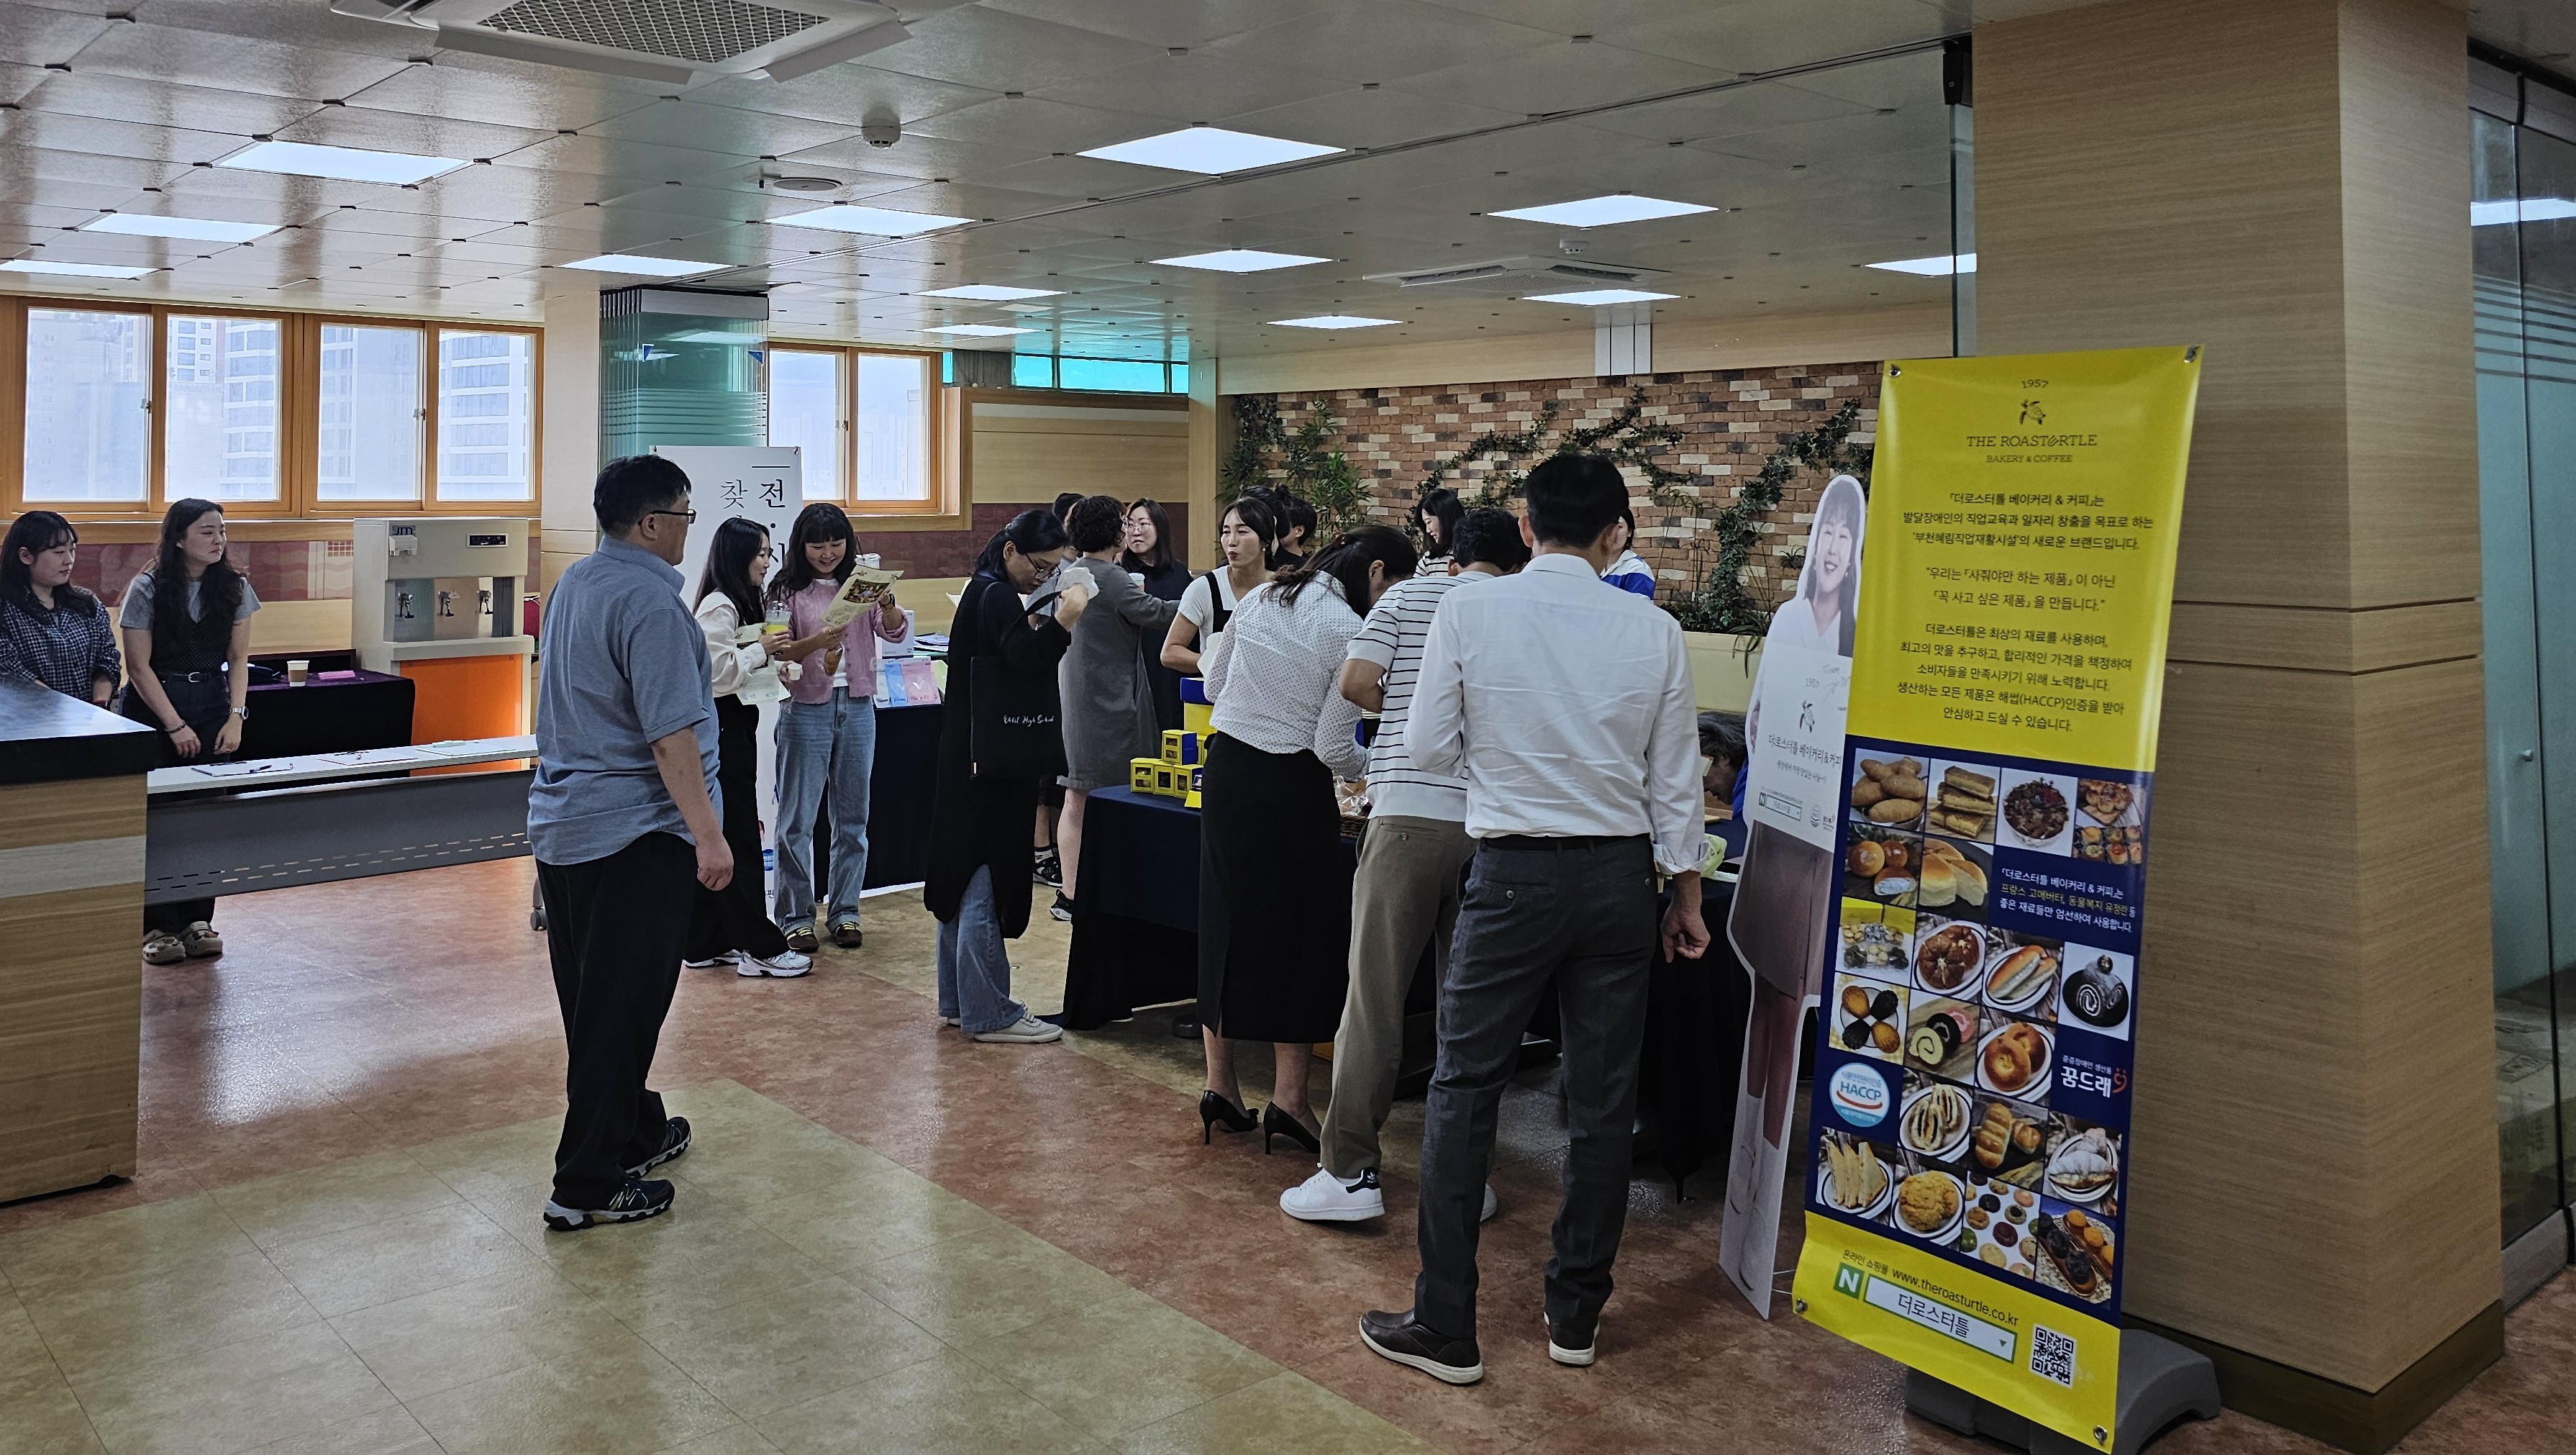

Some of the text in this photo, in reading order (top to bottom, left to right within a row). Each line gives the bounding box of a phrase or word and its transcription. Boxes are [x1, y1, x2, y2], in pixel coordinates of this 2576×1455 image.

[2021, 379, 2049, 389] 1957
[1966, 435, 1997, 448] THE
[1986, 455, 2024, 463] BAKERY
[2033, 455, 2072, 463] COFFEE
[2009, 494, 2052, 507] 베이커리
[2055, 495, 2063, 505] &
[1903, 512, 2154, 530] 발달장애인의 직업교육과 일자리 창출을 목표로 하는
[2033, 535, 2065, 548] 새로운
[2070, 536, 2139, 550] 브랜드입니다.
[2017, 571, 2040, 585] 하는
[2076, 574, 2087, 587] 이
[2091, 575, 2116, 589] 아닌
[1952, 591, 1974, 604] 사고
[1978, 593, 1999, 607] 싶은
[2034, 595, 2044, 609] 을
[1926, 623, 1986, 639] 더로스터틀은
[1989, 627, 2021, 641] 최상의
[2024, 630, 2057, 645] 재료를
[1901, 641, 2132, 671] 최고의 맛을 추구하고, 합리적인 가격을 책정하여
[1916, 663, 2111, 692] 소비자들을 만족시키기 위해 노력합니다.
[1897, 681, 2124, 716] 생산하는 모든 제품은 해썹(HACCP)인증을 받아
[1944, 706, 2072, 733] 안심하고 드실 수 있습니다.
[2050, 877, 2086, 893] 베이커리
[2088, 884, 2095, 894] &
[2000, 897, 2016, 910] 좋은
[2019, 902, 2053, 917] 재료들만
[2055, 908, 2091, 925] 엄선하여
[2001, 884, 2026, 897] 프랑스
[2068, 895, 2103, 912] 동물복지
[2106, 902, 2128, 916] 유정란
[2129, 906, 2136, 917] 등
[1840, 1080, 1882, 1102] HACCP
[2060, 1066, 2112, 1098] 꿈드래
[1842, 1249, 1889, 1276] 온라인 쇼핑몰
[1892, 1268, 2020, 1327] www.theroasturtle.co.kr
[1898, 1293, 1970, 1339] 더로스터틀
